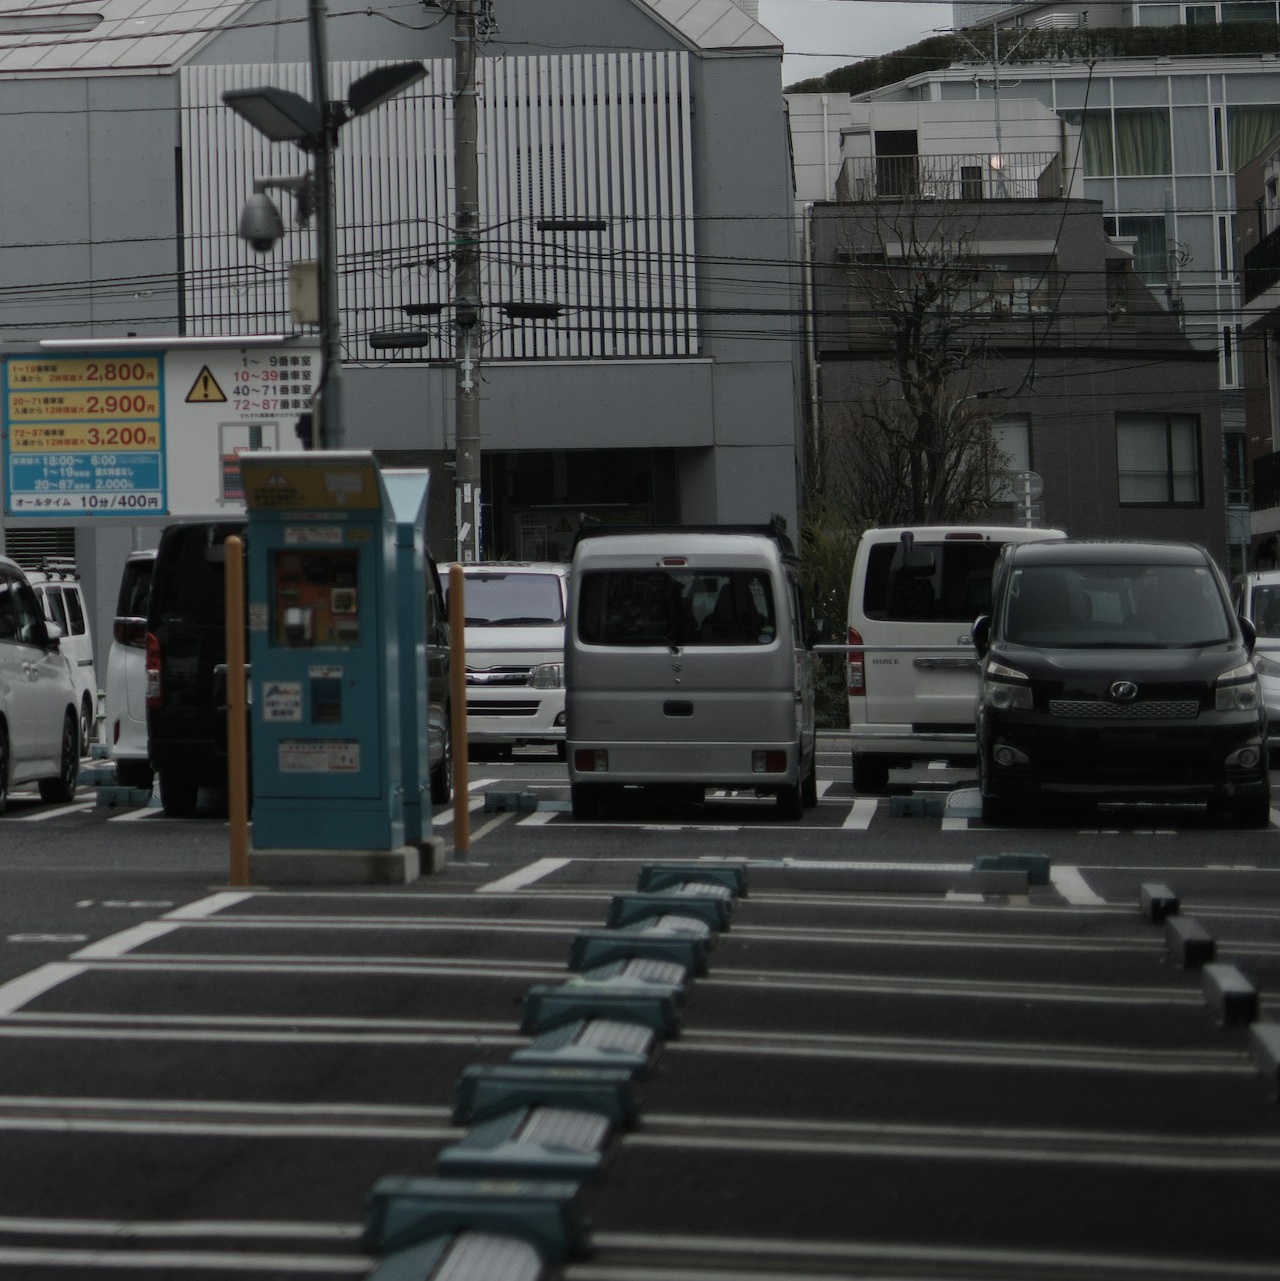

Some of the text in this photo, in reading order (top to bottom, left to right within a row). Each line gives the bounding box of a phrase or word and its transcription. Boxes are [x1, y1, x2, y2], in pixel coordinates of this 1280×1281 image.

[86, 363, 154, 382] 2,800円
[87, 395, 155, 414] 2,900円
[88, 428, 156, 446] 3,200円
[43, 467, 90, 477] 1〜19
[34, 479, 90, 489] 20〜87
[81, 495, 158, 507] 10分/400円
